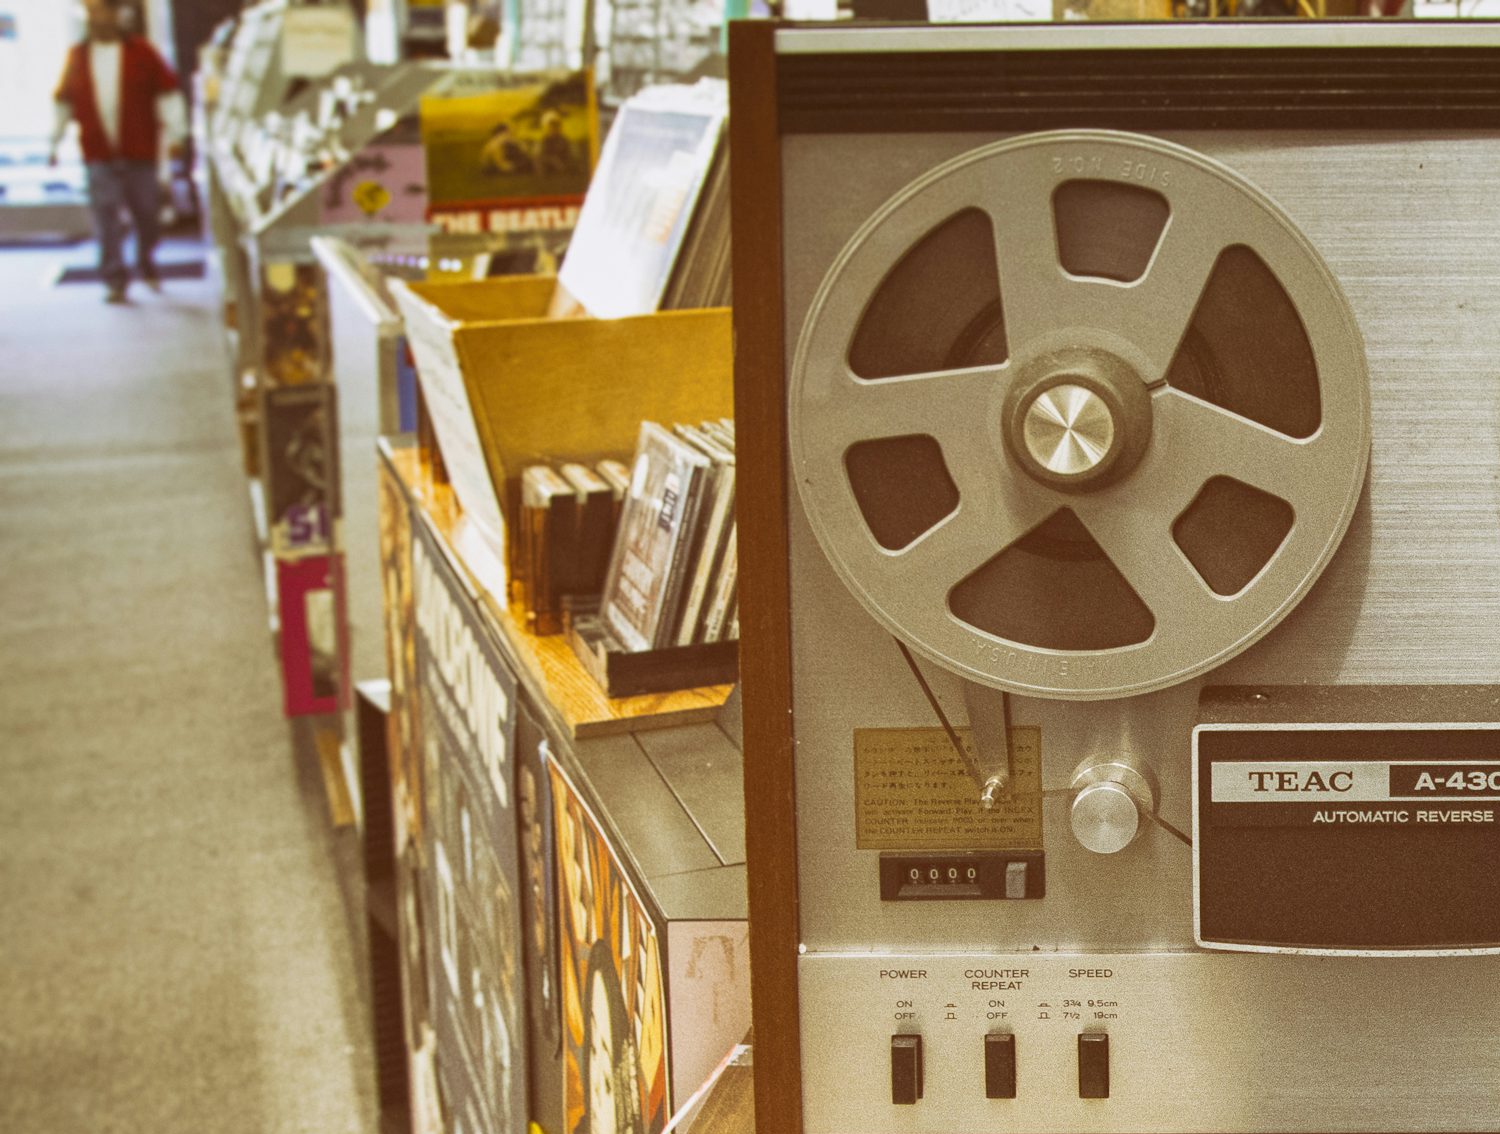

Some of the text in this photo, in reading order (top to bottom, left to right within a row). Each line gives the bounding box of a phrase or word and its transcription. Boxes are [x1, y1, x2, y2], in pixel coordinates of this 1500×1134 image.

[489, 206, 579, 232] BEATLE
[1249, 771, 1354, 793] TEAC
[1313, 810, 1495, 824] AUTOMATIC REVERSE
[880, 970, 928, 979] POWER
[964, 969, 1030, 978] COUNTER
[1068, 969, 1113, 978] SPEED
[971, 981, 1023, 990] REPEAT
[896, 1000, 913, 1008] ON
[894, 1012, 916, 1020] OFF
[986, 1012, 1008, 1020] OFF
[1094, 1012, 1118, 1020] 19cm
